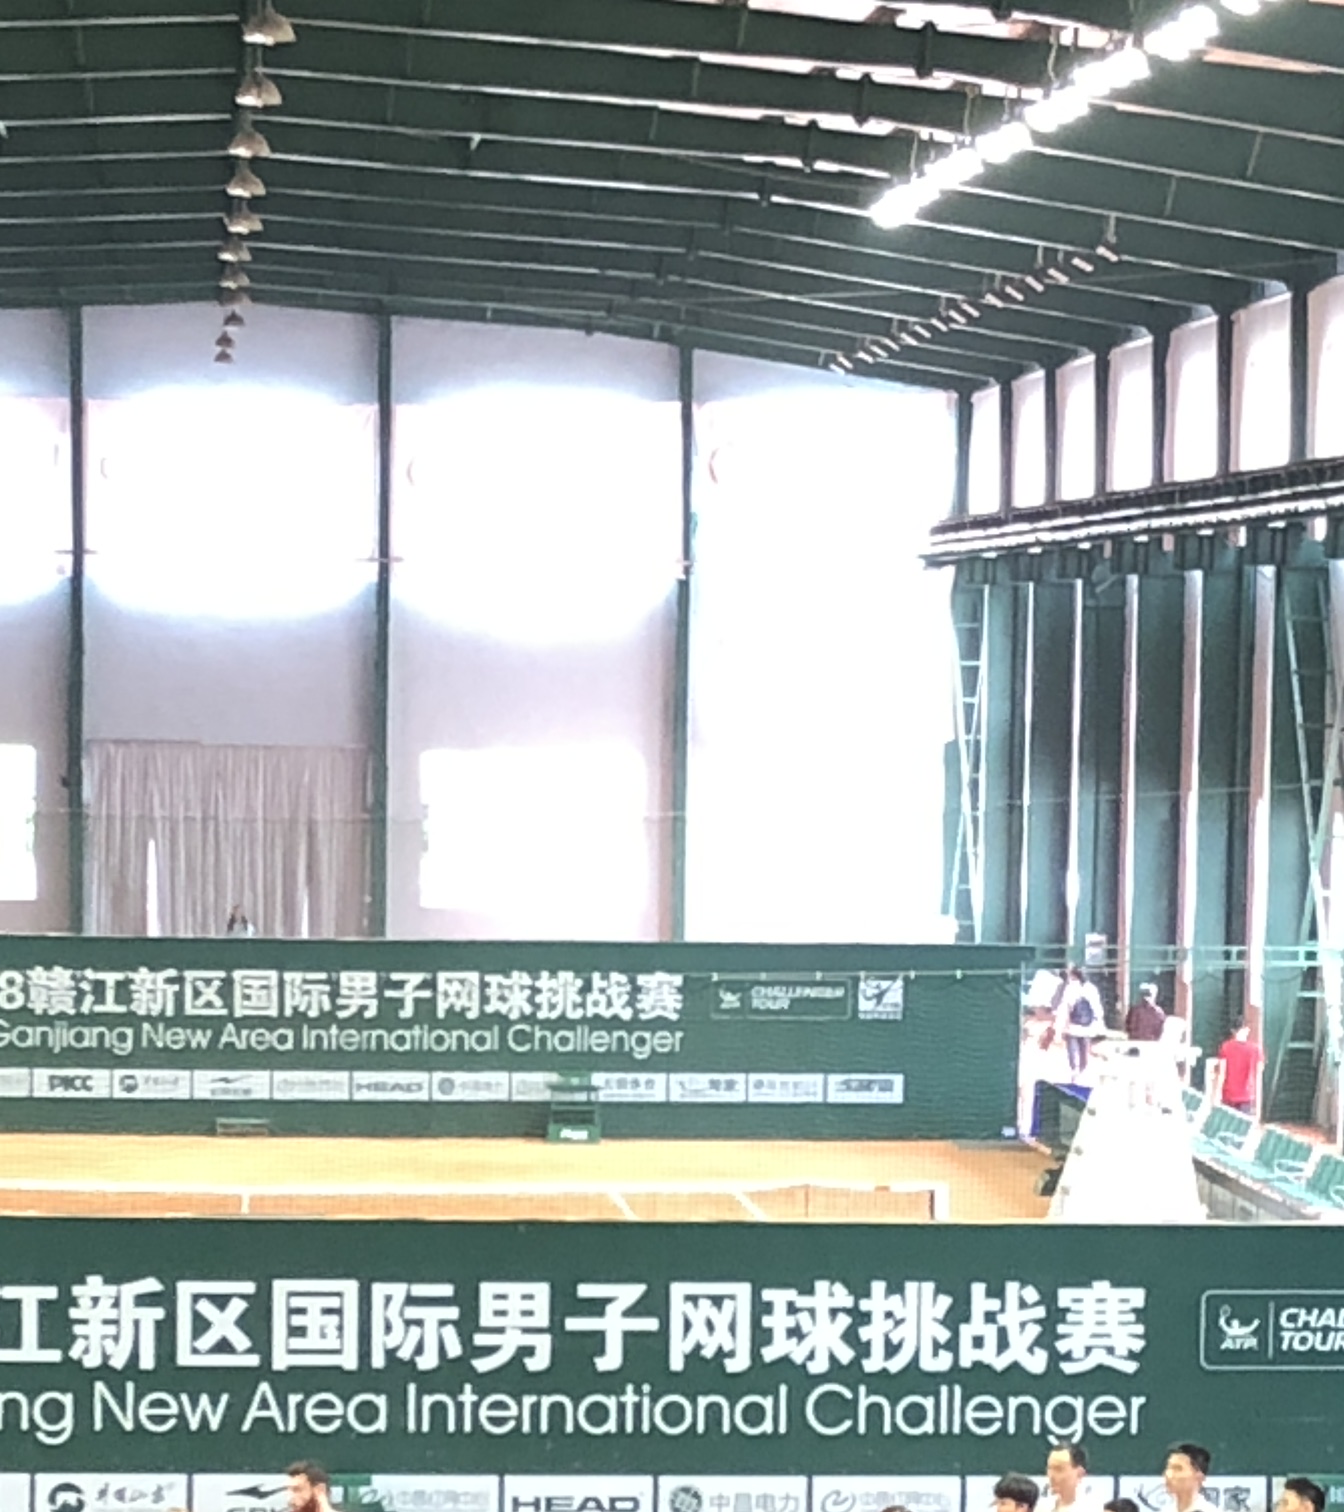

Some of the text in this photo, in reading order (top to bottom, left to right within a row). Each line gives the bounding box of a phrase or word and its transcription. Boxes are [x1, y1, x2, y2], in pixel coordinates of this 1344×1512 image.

[141, 1021, 212, 1050] New
[218, 1021, 295, 1051] Area
[301, 1023, 500, 1052] International
[506, 1024, 685, 1060] Challenger
[47, 1073, 94, 1093] PICC
[1219, 1336, 1260, 1351] ATP
[92, 1380, 230, 1434] New
[241, 1380, 389, 1434] Area
[406, 1380, 788, 1436] International
[804, 1382, 1147, 1446] Challenger
